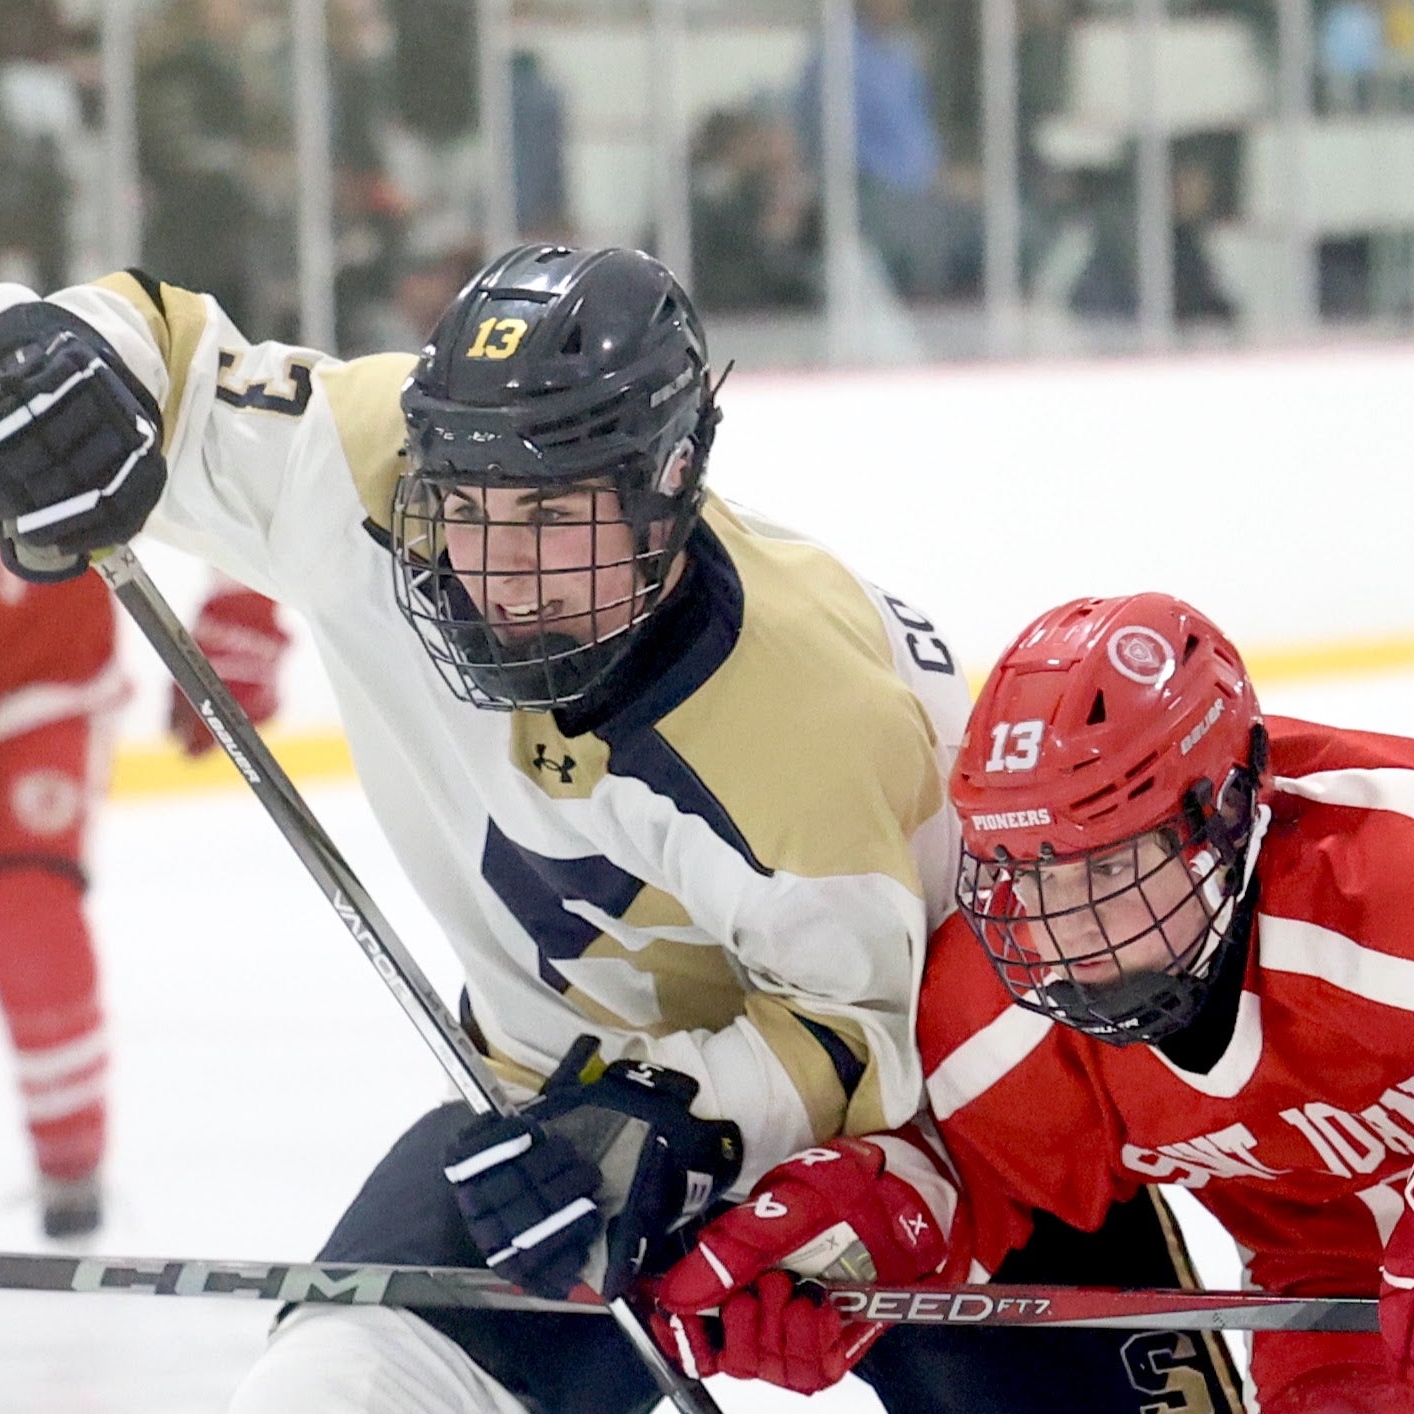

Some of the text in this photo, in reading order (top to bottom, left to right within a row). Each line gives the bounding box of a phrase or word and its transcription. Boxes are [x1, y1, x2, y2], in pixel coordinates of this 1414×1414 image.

[466, 317, 528, 359] 13
[984, 719, 1045, 772] 13
[971, 808, 1051, 831] PIONEERS
[72, 1257, 393, 1306] CCM
